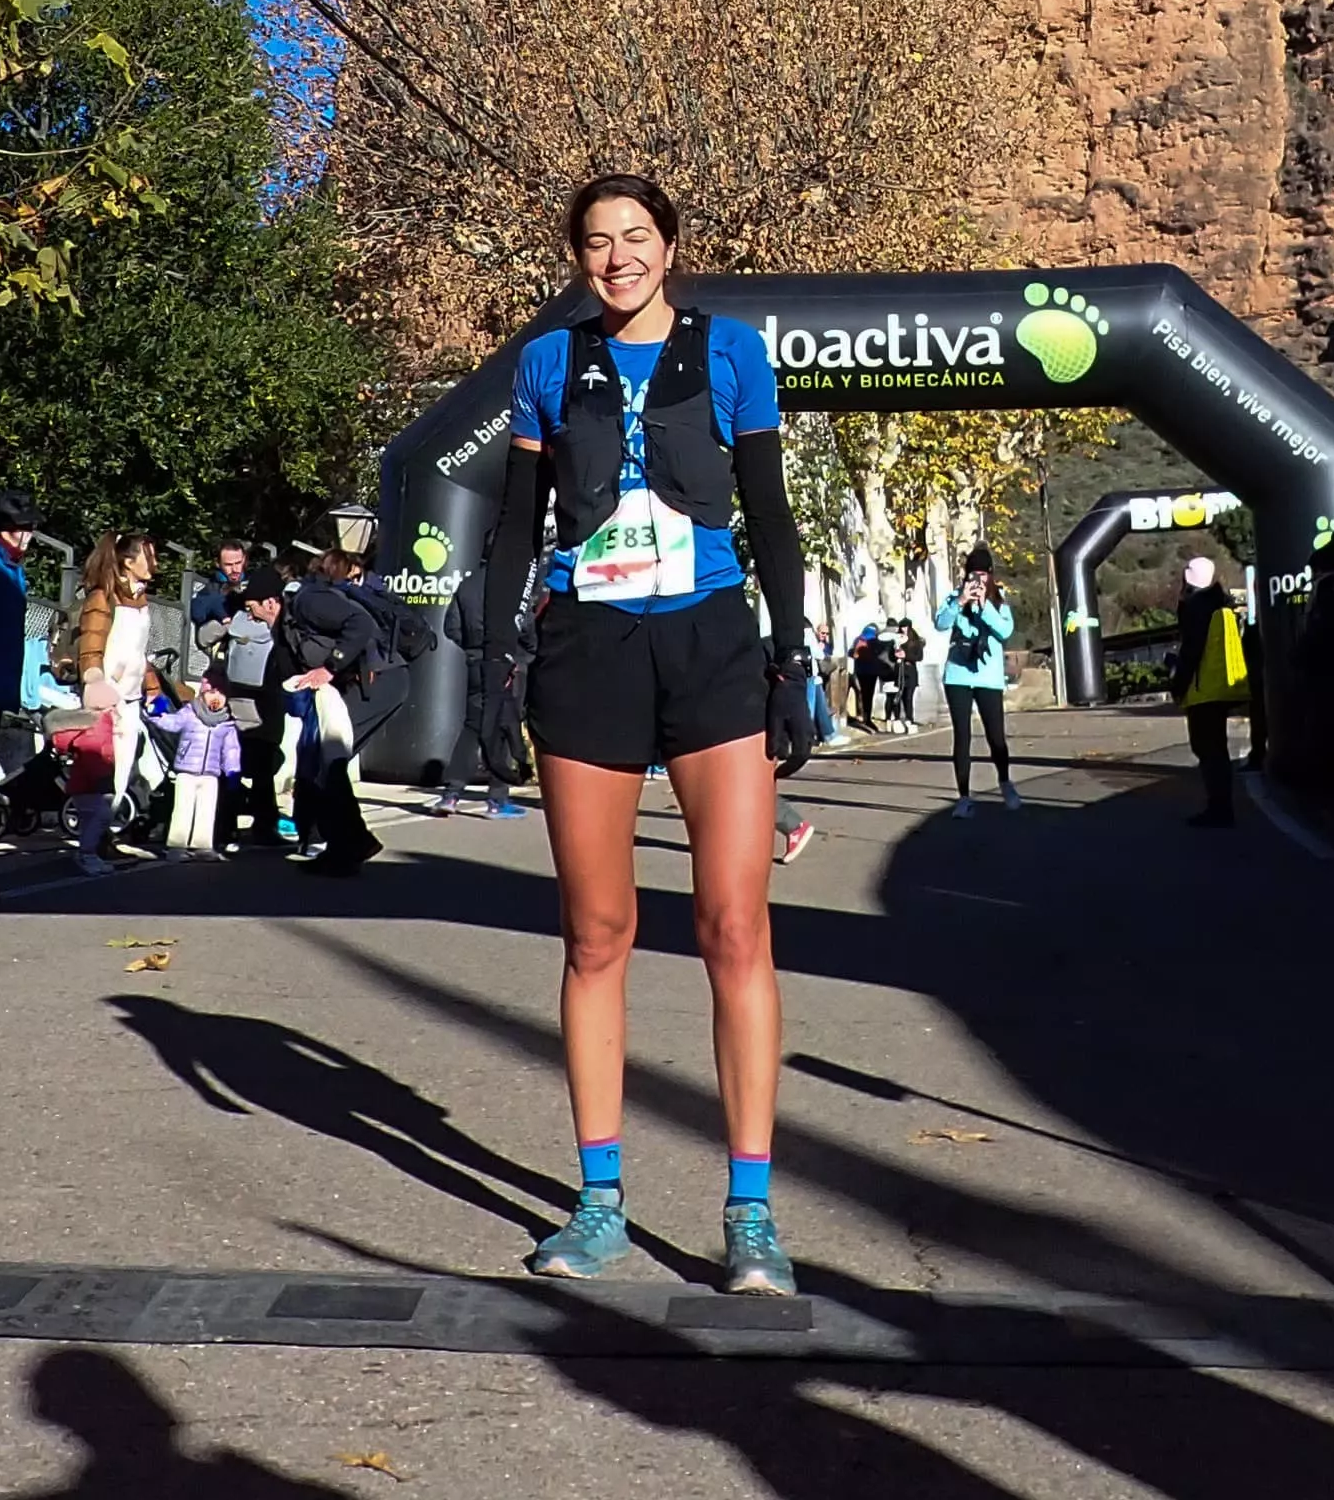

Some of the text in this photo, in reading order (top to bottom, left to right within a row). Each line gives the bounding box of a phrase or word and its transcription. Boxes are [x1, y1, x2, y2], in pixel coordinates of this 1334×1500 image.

[777, 369, 1005, 389] OGÍA Y BIOMECÁNICA
[1153, 318, 1329, 465] Pisa bien, vive mejor
[436, 441, 479, 476] Pisa
